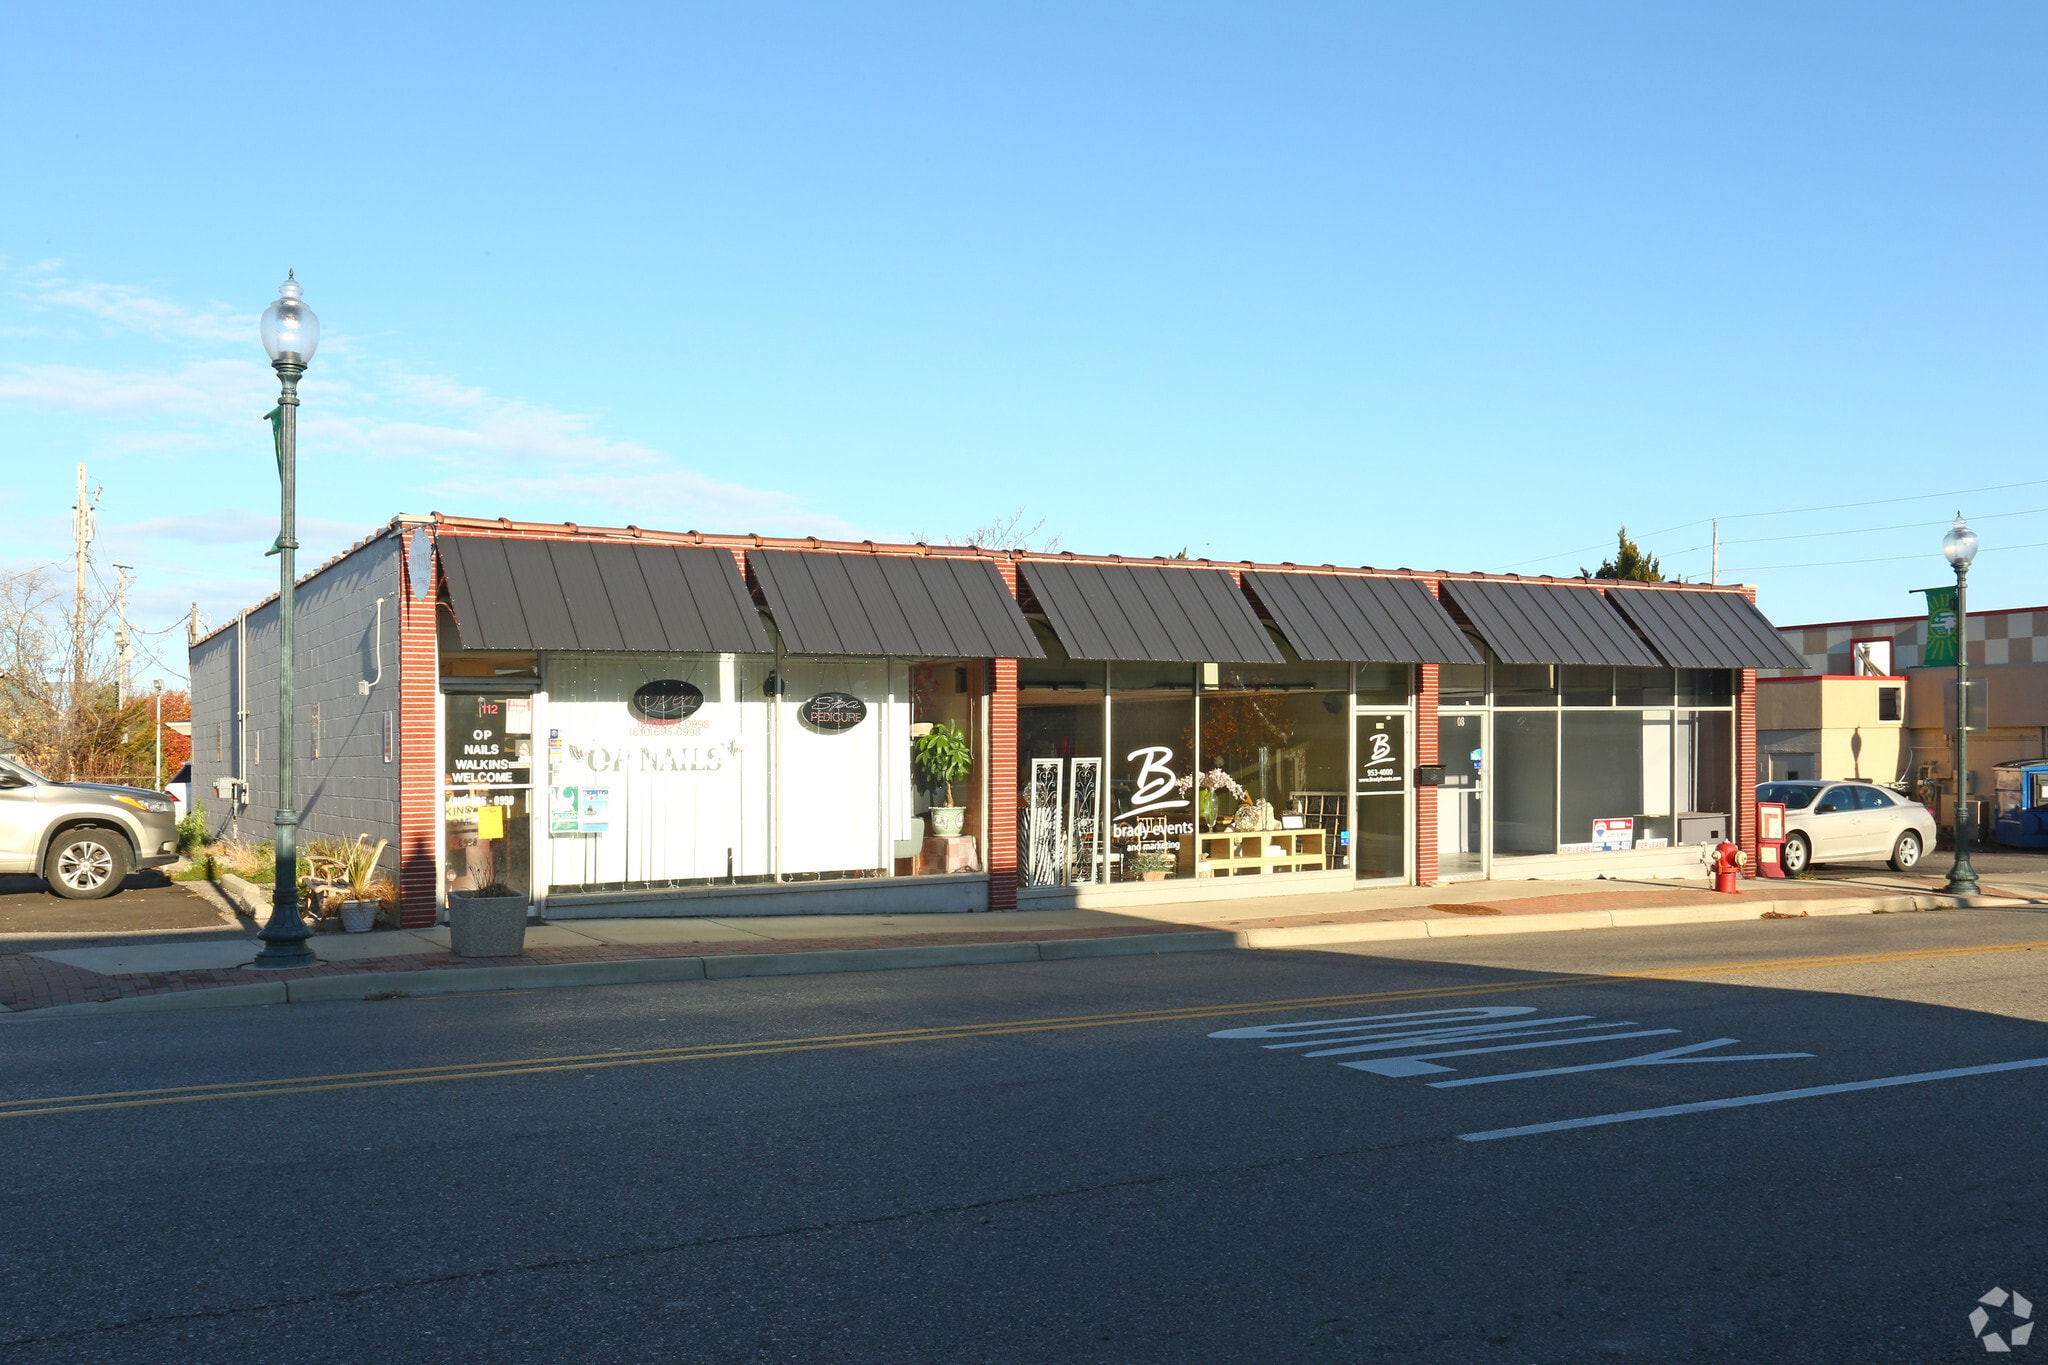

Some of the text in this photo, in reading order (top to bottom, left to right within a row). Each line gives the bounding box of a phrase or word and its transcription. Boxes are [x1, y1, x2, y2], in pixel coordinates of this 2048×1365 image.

[482, 704, 498, 714] 112
[811, 696, 861, 711] Spa
[810, 711, 862, 722] PEDICURE
[473, 729, 492, 740] OP
[464, 744, 500, 755] NAILS
[455, 759, 509, 770] WALKINS
[640, 747, 722, 771] NAILS
[452, 772, 513, 783] WELCOME
[1127, 746, 1177, 805] B
[1113, 821, 1194, 840] brady events
[1127, 840, 1181, 852] and marketing
[1572, 845, 1591, 853] LEASE
[1649, 840, 1666, 849] LEASE
[1207, 1006, 1817, 1088] ONLY
